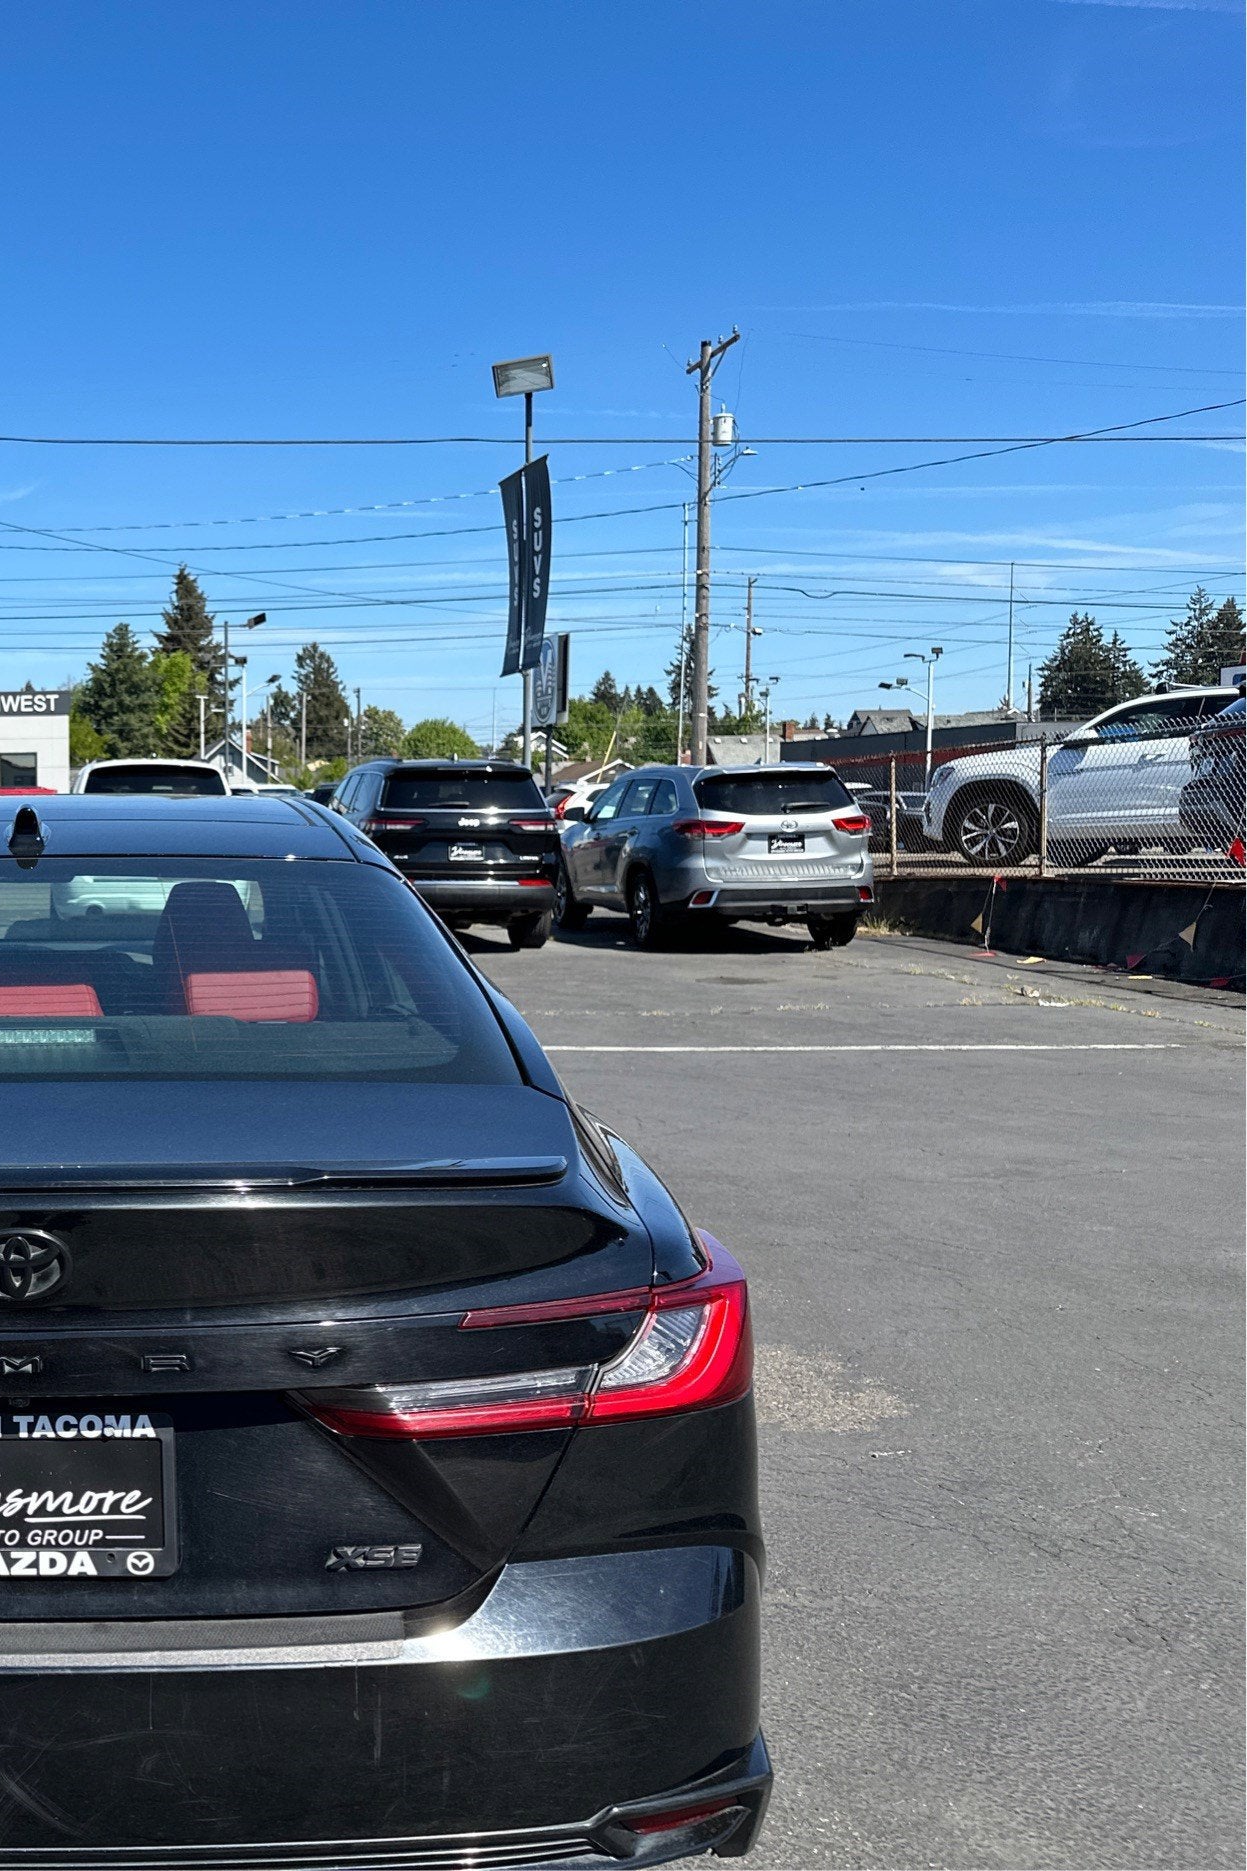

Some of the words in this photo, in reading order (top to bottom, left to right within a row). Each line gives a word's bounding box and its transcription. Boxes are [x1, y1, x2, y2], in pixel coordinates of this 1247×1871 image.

[533, 507, 543, 599] SUVS
[13, 1414, 156, 1438] TACOMA
[27, 1530, 103, 1546] GROUP
[325, 1544, 422, 1571] XSE
